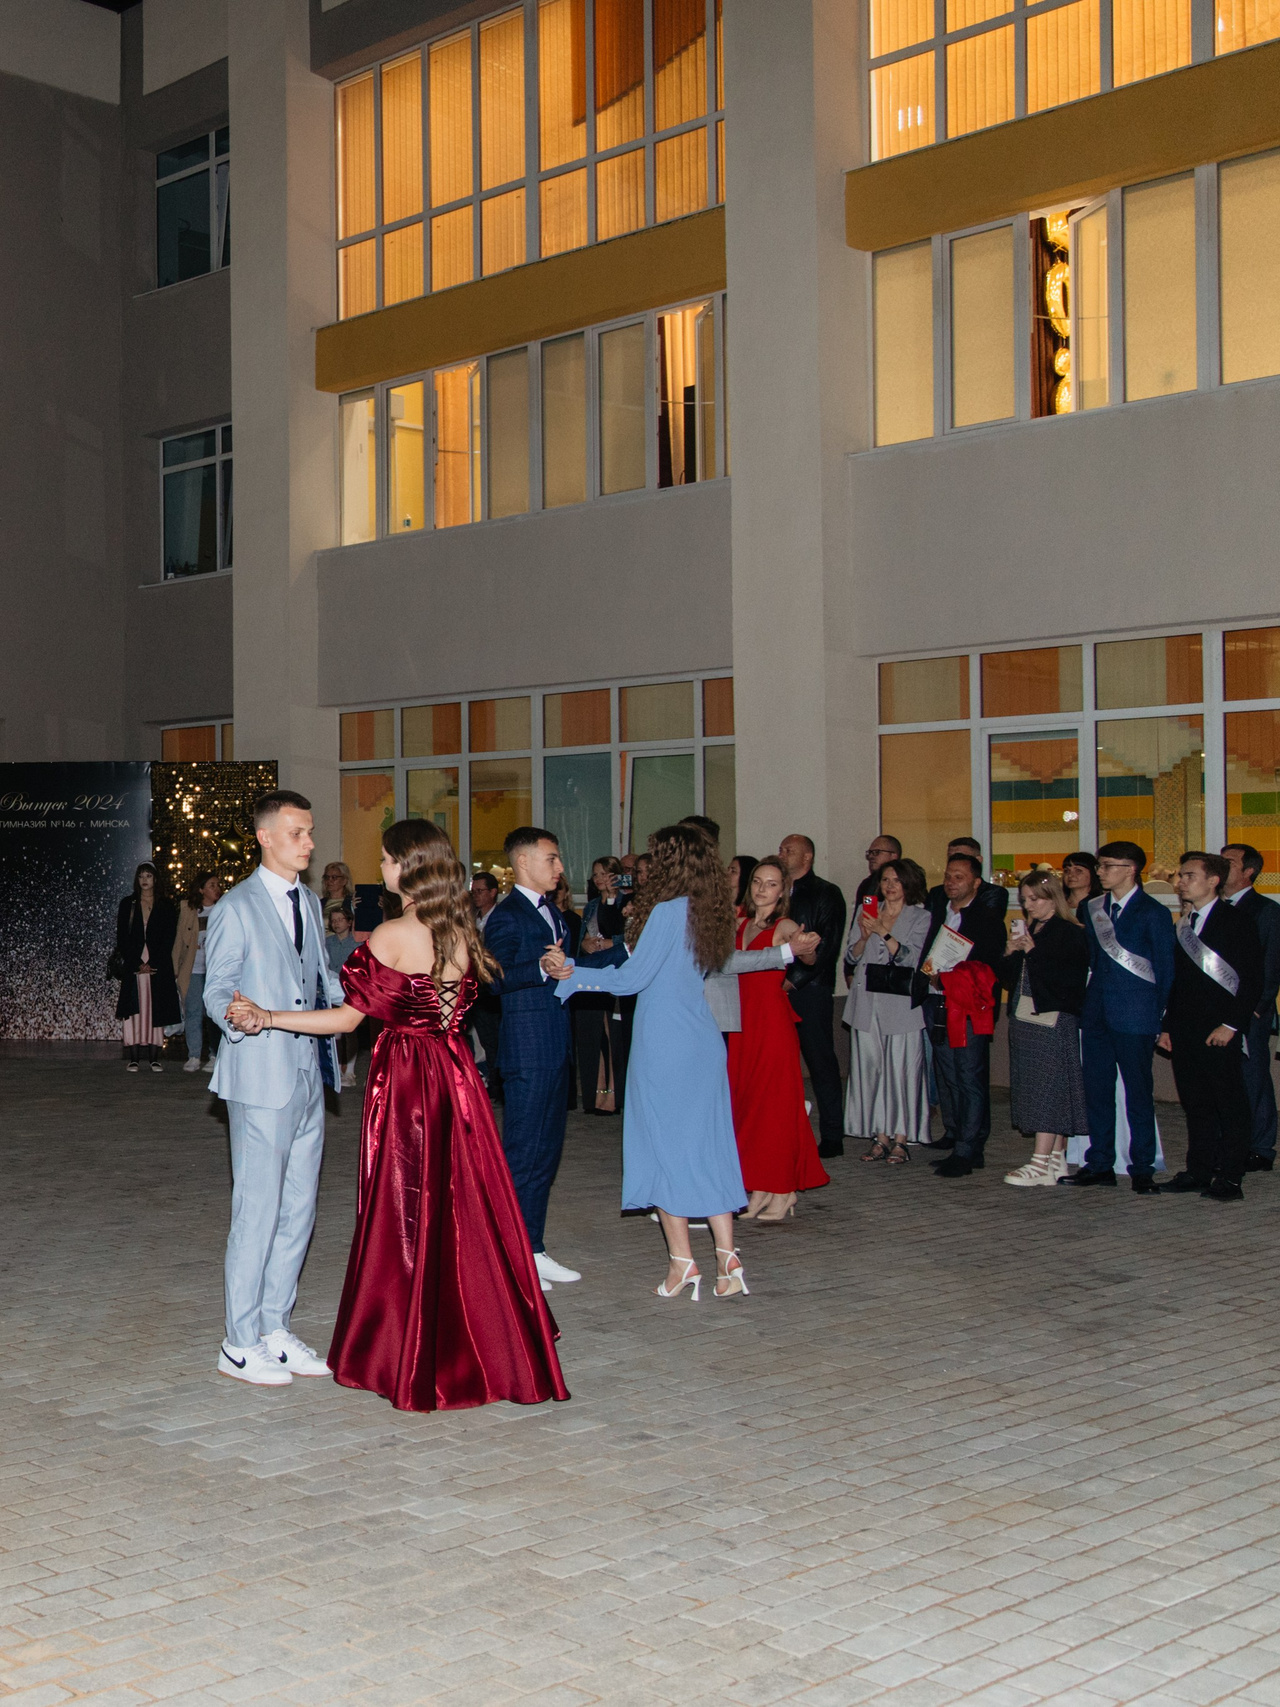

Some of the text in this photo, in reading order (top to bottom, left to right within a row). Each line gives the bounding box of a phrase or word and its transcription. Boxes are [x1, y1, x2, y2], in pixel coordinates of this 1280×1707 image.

[0, 791, 129, 817] Выпуск 2024
[0, 820, 47, 829] ГИМНАЗИЯ
[80, 821, 86, 829] г.
[90, 819, 131, 828] МИНСКА
